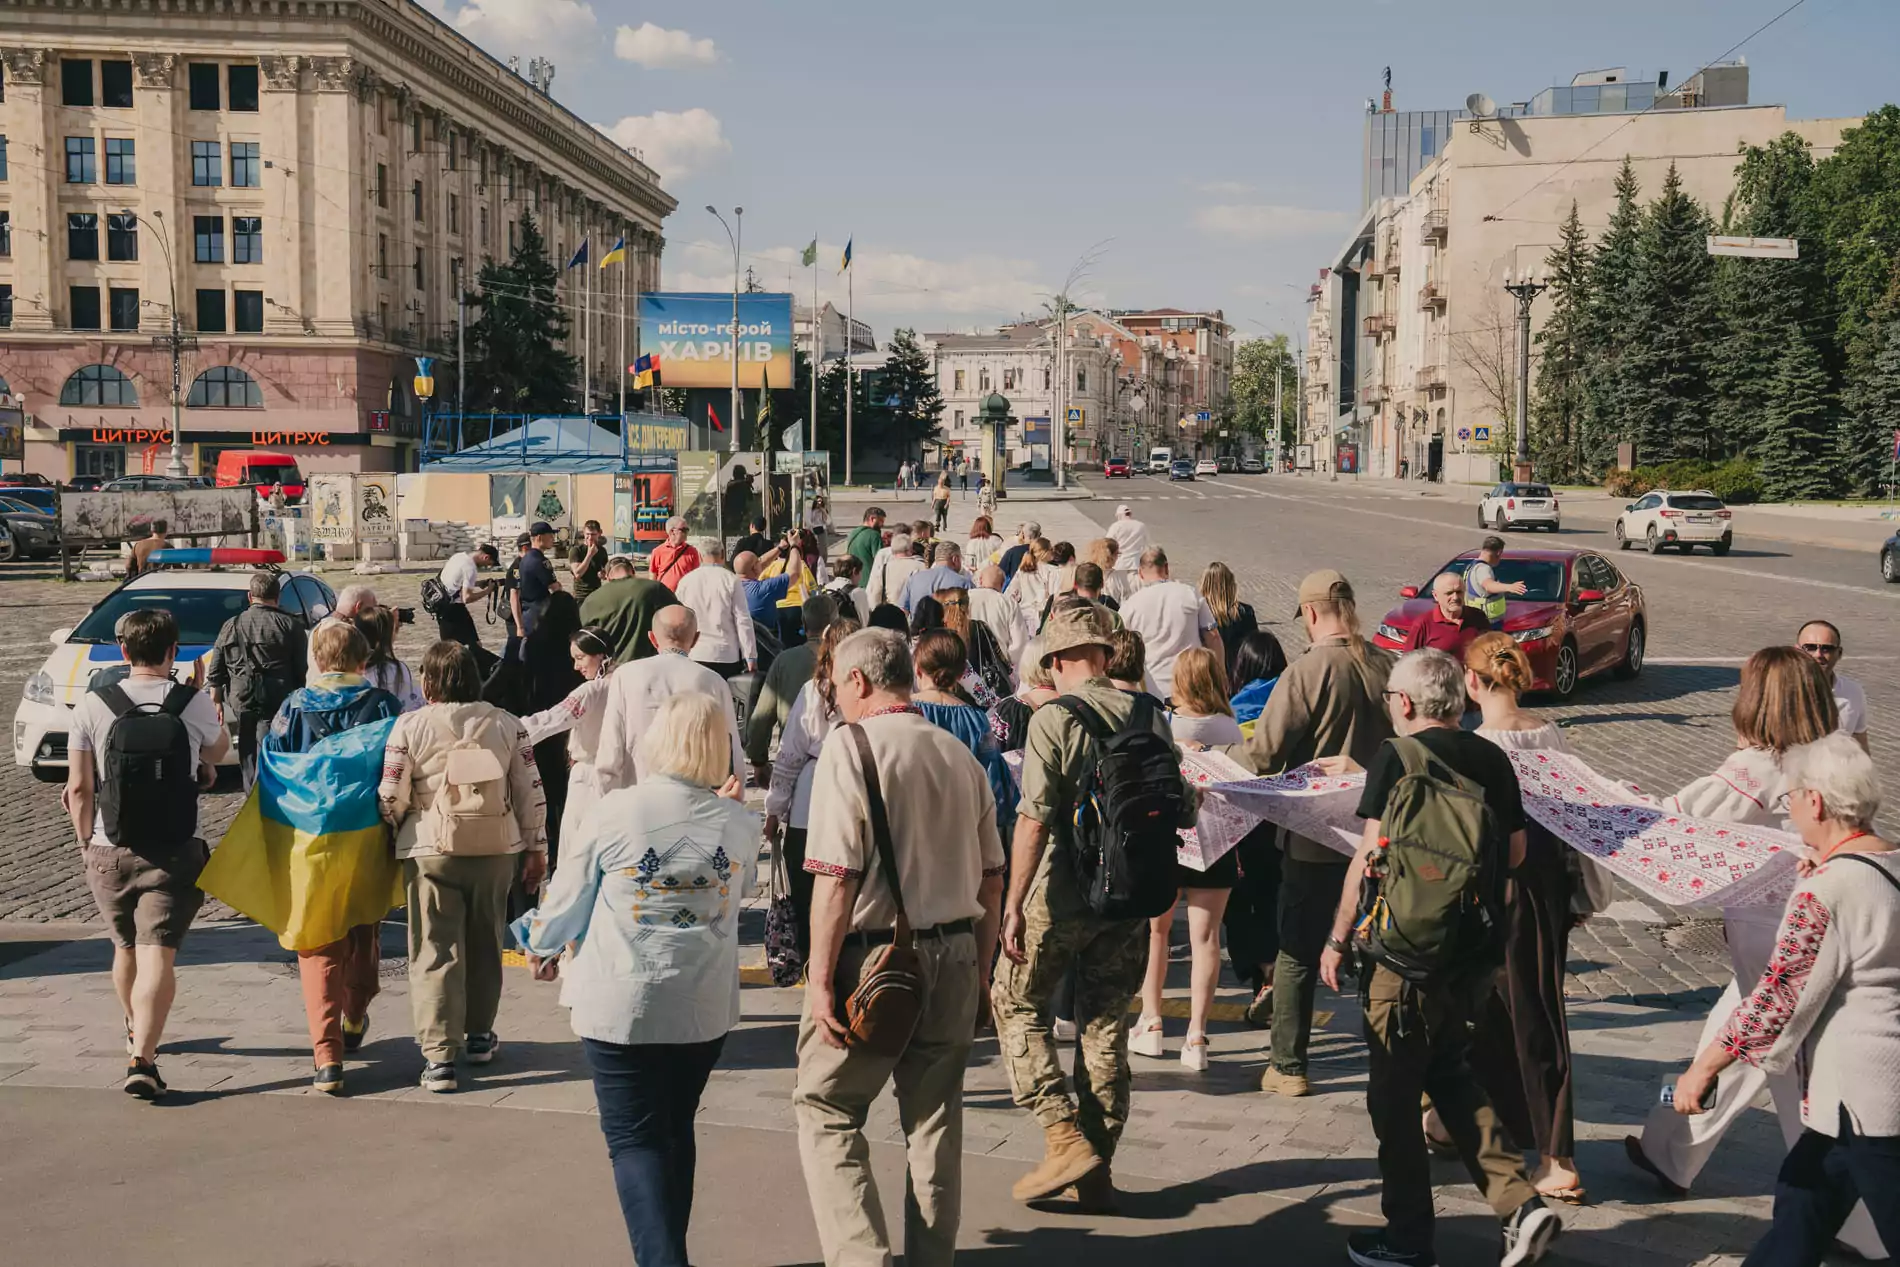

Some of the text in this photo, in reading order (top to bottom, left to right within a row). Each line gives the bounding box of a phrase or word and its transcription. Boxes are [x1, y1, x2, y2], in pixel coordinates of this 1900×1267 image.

[658, 320, 772, 338] місто-герой
[659, 341, 773, 362] ХАРКІВ
[92, 429, 173, 443] ЦИТРУС
[252, 431, 330, 446] ЦИТРУС
